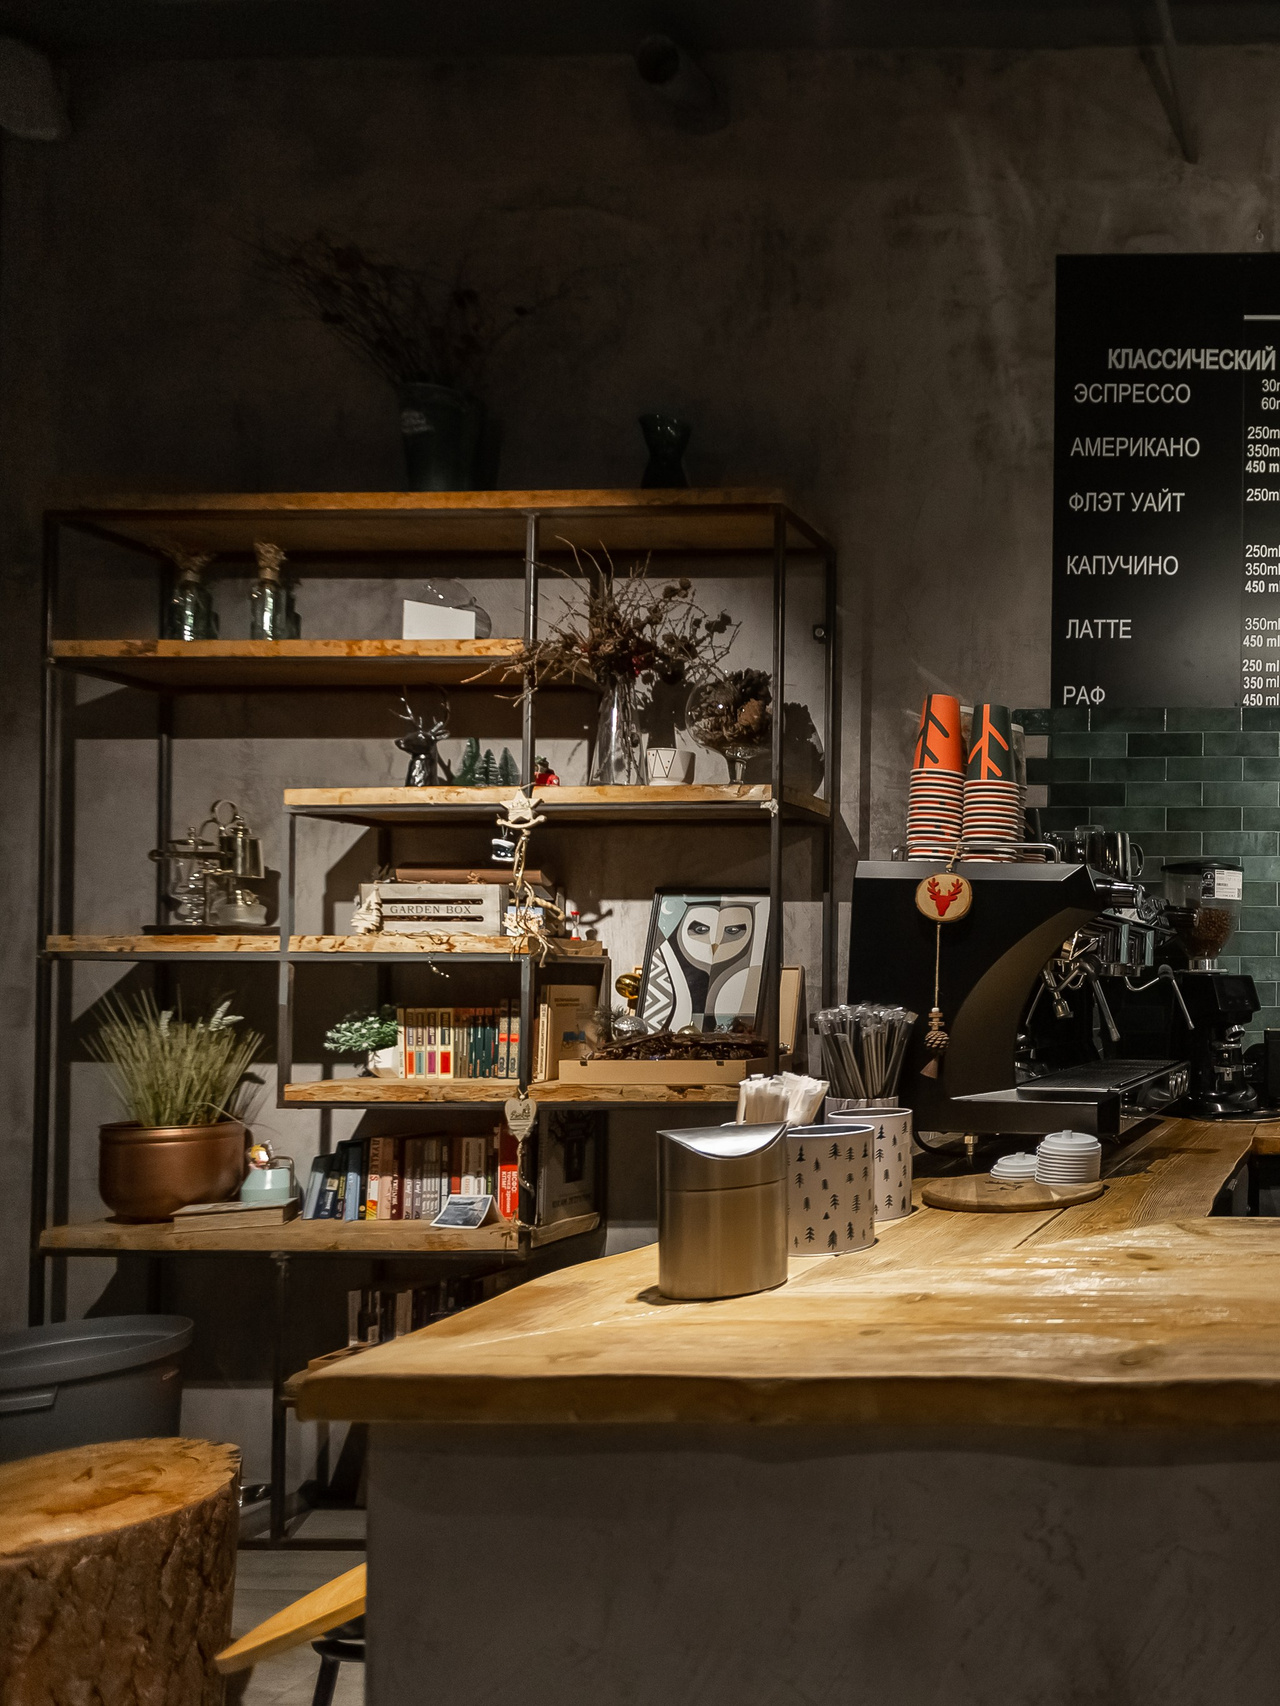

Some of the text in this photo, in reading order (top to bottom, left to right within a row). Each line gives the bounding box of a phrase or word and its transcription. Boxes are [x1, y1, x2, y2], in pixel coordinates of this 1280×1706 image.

[1108, 346, 1275, 370] КЛАССИЧЕСКИЙ
[1075, 384, 1190, 403] ЭСПРЕССО
[1071, 437, 1200, 457] АМЕРИКАНО
[1246, 461, 1265, 473] 450
[1069, 489, 1185, 511] ФЛЭТ УАЙТ
[1246, 545, 1280, 557] 250ml
[1067, 556, 1178, 575] КАПУЧИНО
[1246, 563, 1280, 575] 350ml
[1245, 581, 1265, 592] 450
[1066, 620, 1131, 638] ЛАТТЕ
[1245, 618, 1280, 630] 350ml
[1243, 635, 1263, 647] 450
[1267, 635, 1280, 647] ml
[1243, 659, 1262, 671] 250
[1266, 660, 1279, 672] ml
[1244, 677, 1263, 689] 350
[1266, 676, 1279, 687] ml
[1064, 686, 1105, 704] РАФ
[1243, 694, 1262, 704] 450
[1266, 694, 1279, 704] ml
[390, 905, 472, 914] GARDEN BOX
